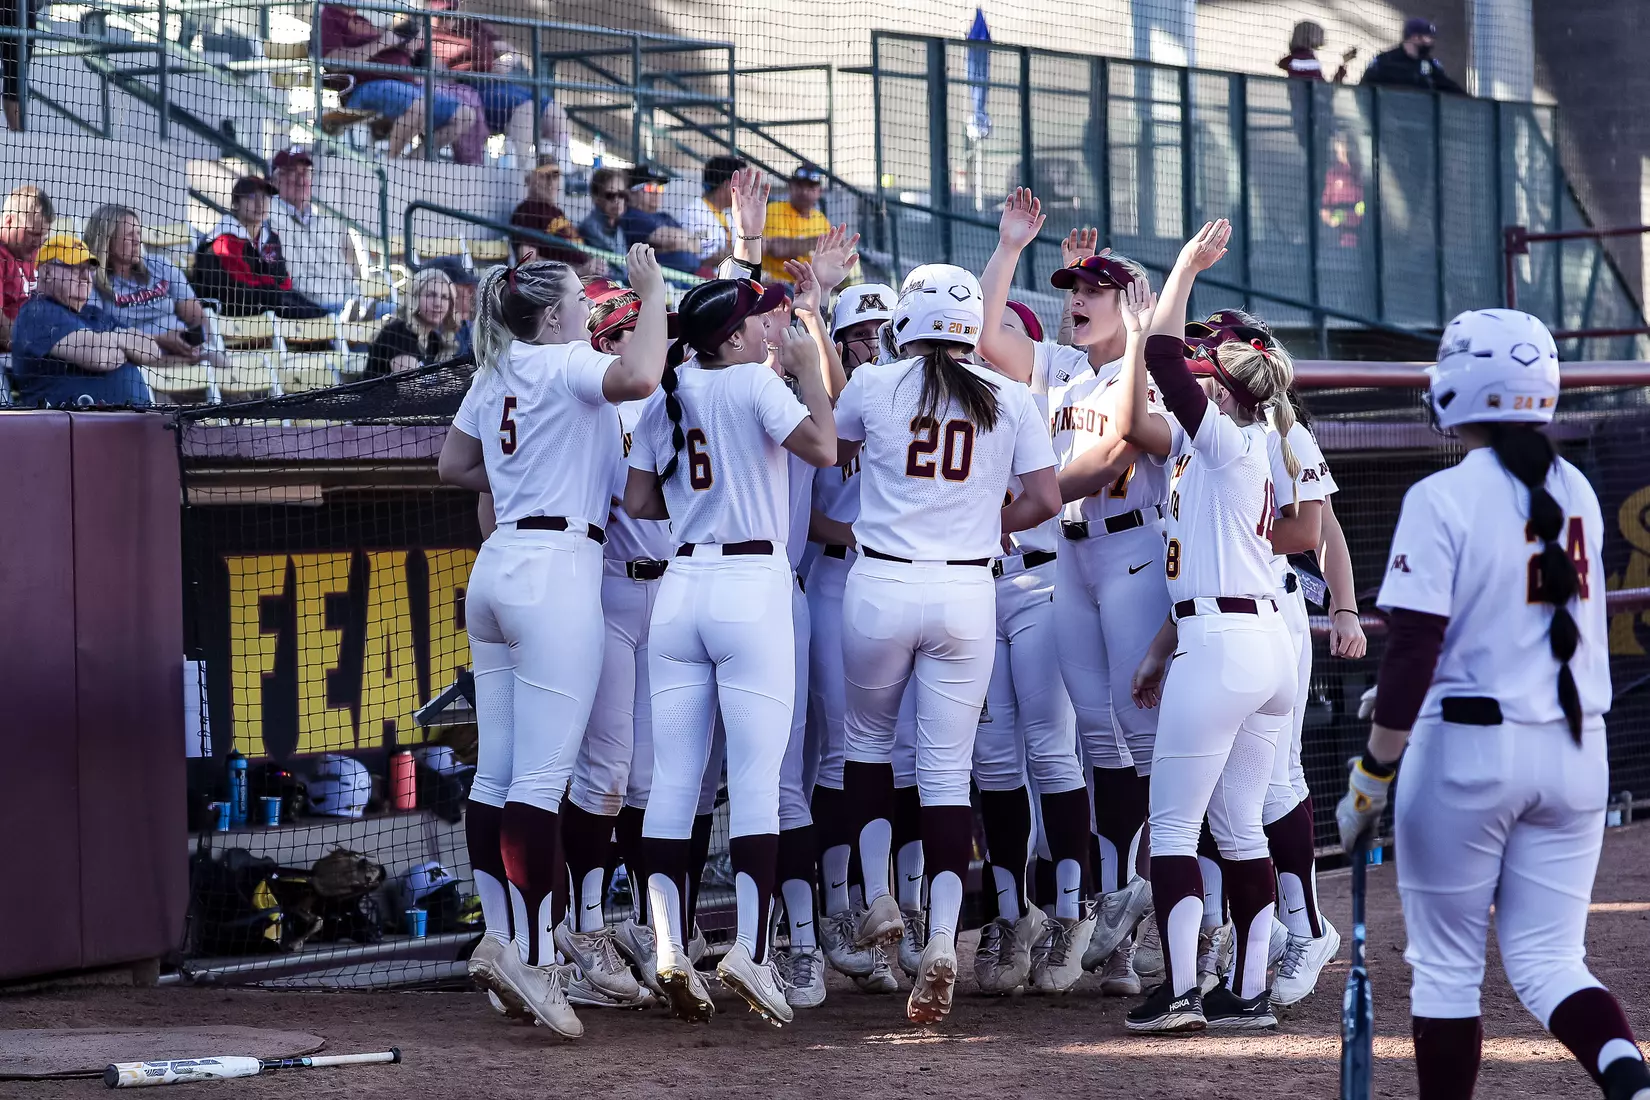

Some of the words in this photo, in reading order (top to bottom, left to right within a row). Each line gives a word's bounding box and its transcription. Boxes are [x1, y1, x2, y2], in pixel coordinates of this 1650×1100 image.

[855, 293, 888, 314] M
[948, 322, 963, 335] 20
[1513, 396, 1533, 410] 24
[498, 395, 519, 456] 5
[685, 427, 715, 492] 6
[905, 415, 976, 484] 20
[1300, 468, 1321, 483] M
[1165, 537, 1182, 581] 8
[1168, 999, 1191, 1012] HOKA
